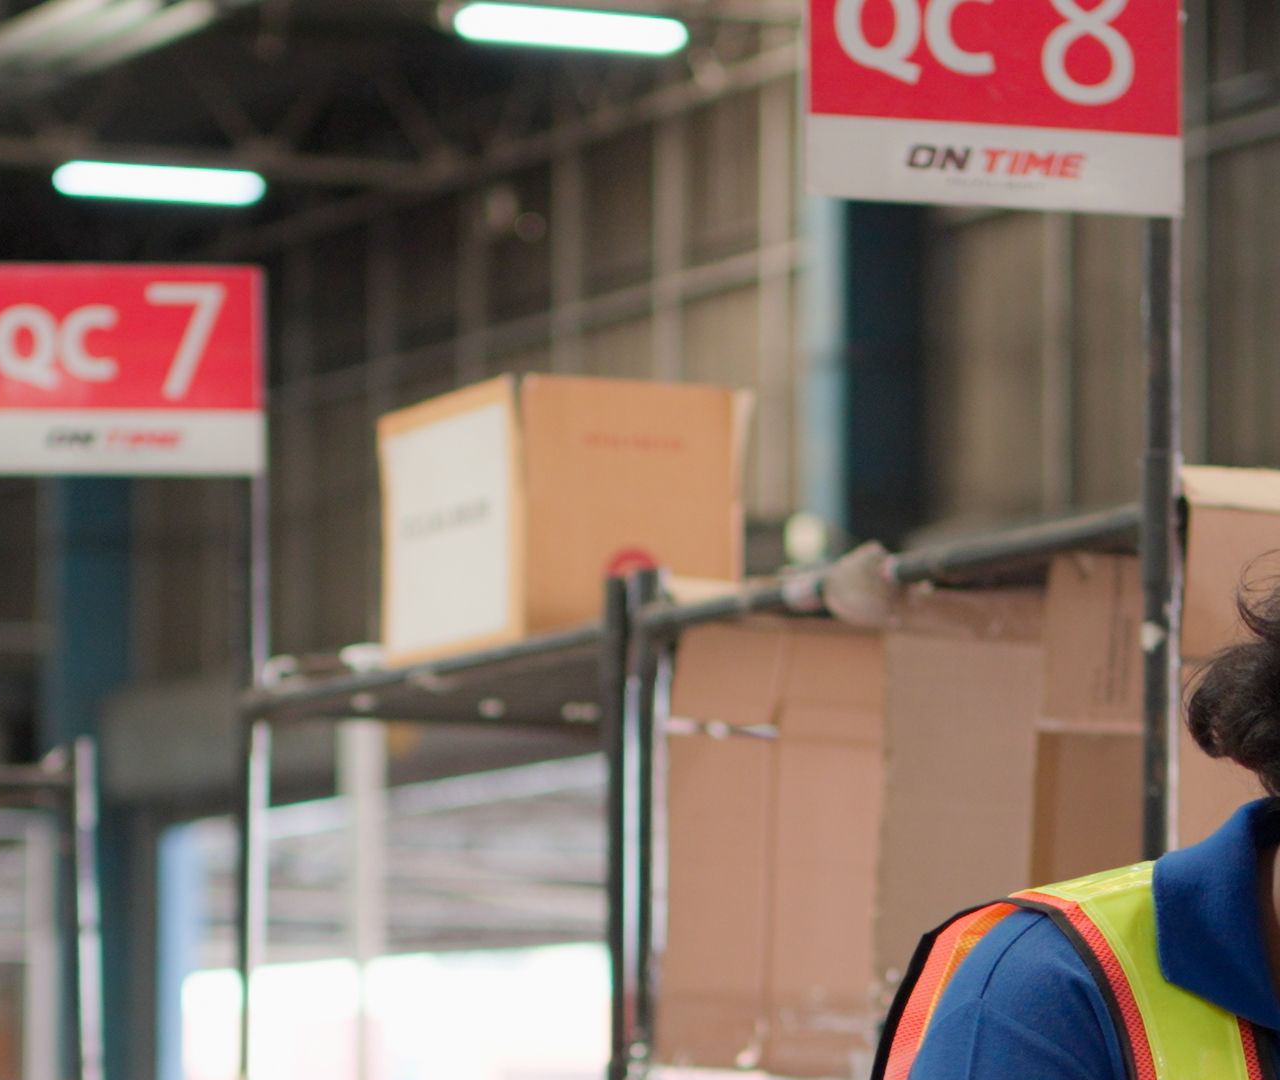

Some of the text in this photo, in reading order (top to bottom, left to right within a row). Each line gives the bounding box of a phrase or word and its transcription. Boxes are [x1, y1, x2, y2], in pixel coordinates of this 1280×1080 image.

[834, 0, 1135, 105] QC 8
[907, 144, 1088, 182] ON TIME
[143, 280, 227, 402] 7
